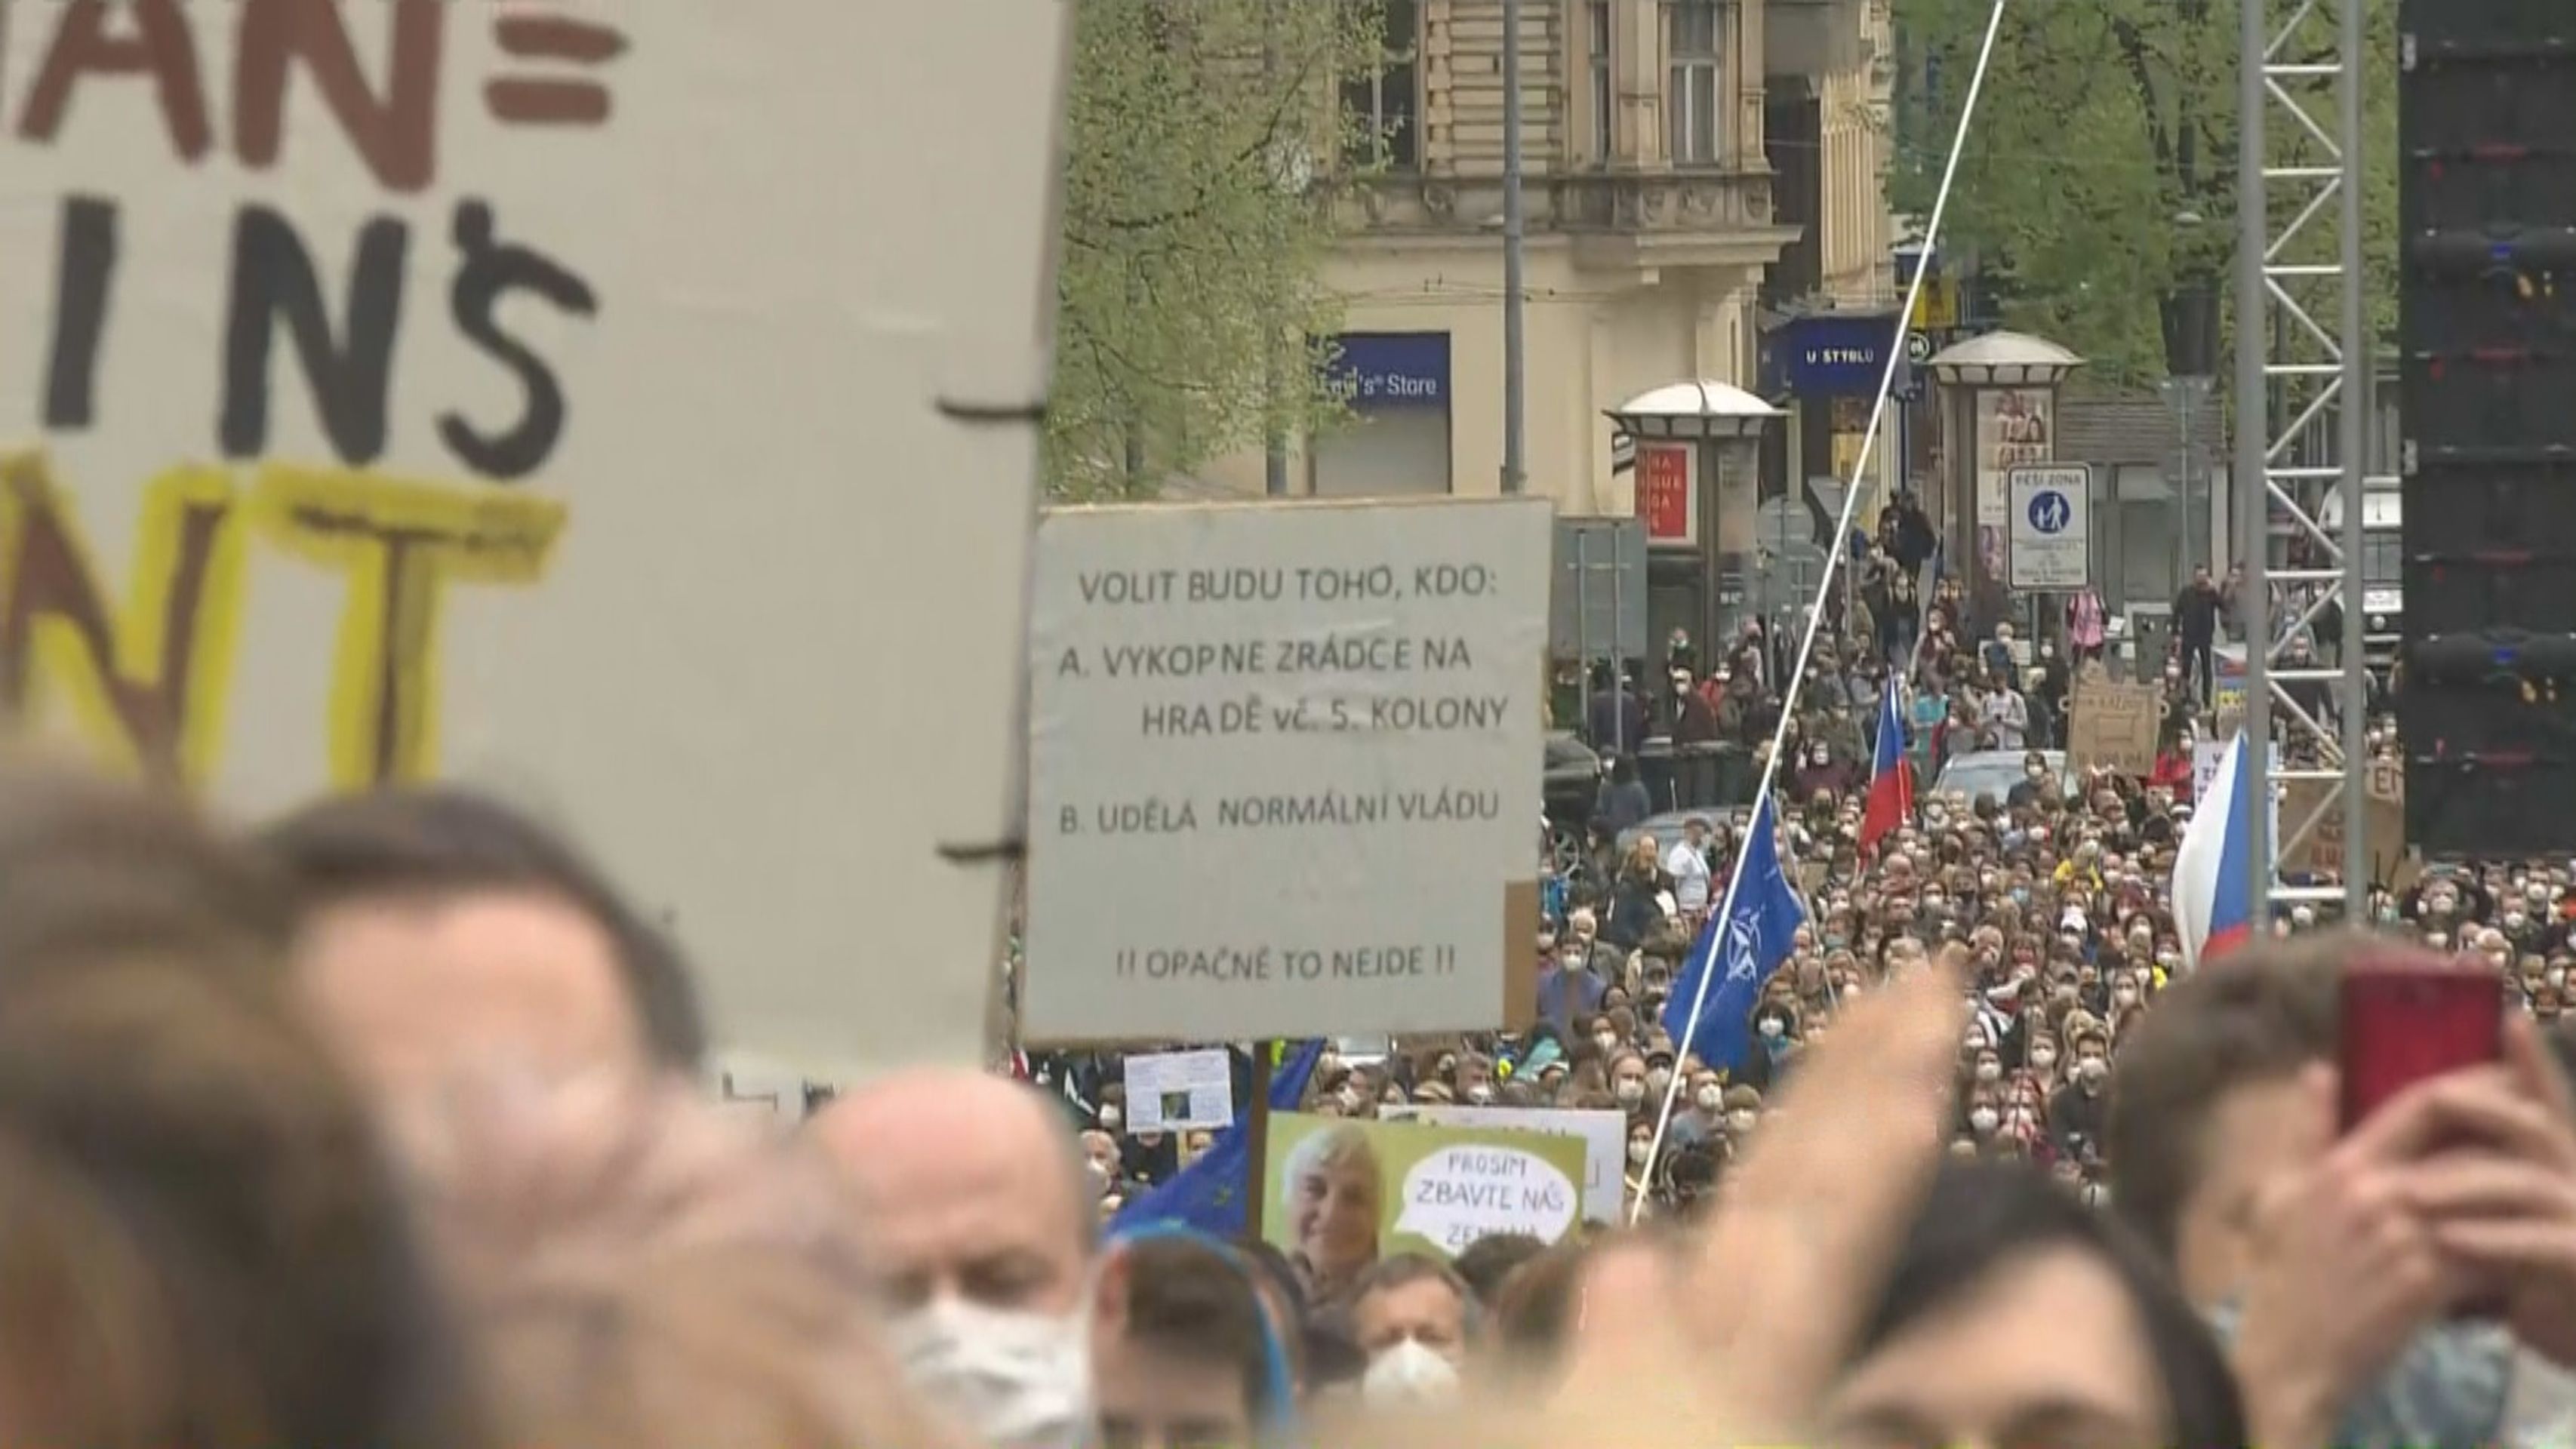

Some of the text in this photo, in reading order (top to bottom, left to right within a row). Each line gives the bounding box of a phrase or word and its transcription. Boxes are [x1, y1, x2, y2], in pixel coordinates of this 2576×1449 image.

[1387, 372, 1437, 395] Store
[1078, 563, 1497, 605] VOLIT BUDU TOHO, KDO:
[1057, 646, 1090, 677] A.
[1276, 632, 1411, 673] ZRÁDCE
[1423, 636, 1472, 670] NA
[1371, 696, 1509, 733] KOLONY
[1059, 804, 1085, 835] B.
[1217, 788, 1389, 827] NORMÁLNÍ
[1397, 783, 1499, 821] VLÁDU
[1283, 949, 1323, 980] TO
[1332, 945, 1423, 978] NEJDE
[1417, 1180, 1512, 1211] ZBAVTE
